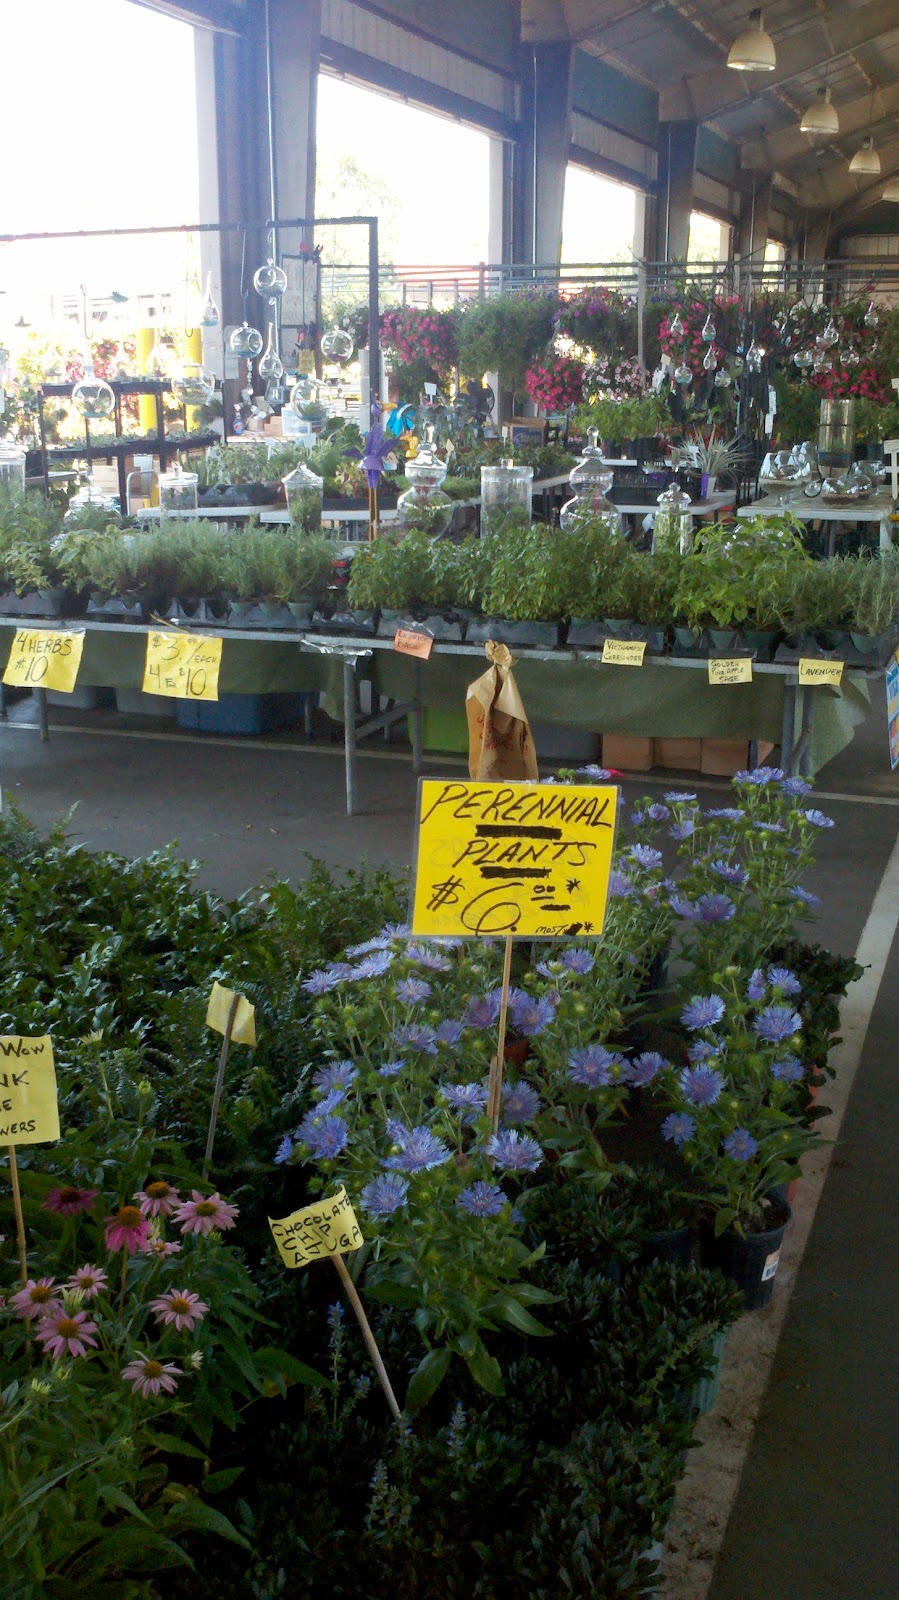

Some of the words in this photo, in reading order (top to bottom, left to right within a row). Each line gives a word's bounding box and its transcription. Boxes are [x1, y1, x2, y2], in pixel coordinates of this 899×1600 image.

[17, 632, 28, 652] 4
[29, 638, 72, 656] HERBS
[15, 656, 48, 682] $10
[149, 664, 161, 689] 4
[179, 668, 207, 696] $10
[718, 675, 740, 683] SAGE
[800, 664, 842, 677] LAVENDER
[420, 784, 612, 828] PERENNIAL
[452, 839, 597, 869] PLANTS
[272, 1194, 352, 1236] CHOCOLATE
[282, 1223, 331, 1251] CHIP
[294, 1225, 361, 1266] AJUGA
